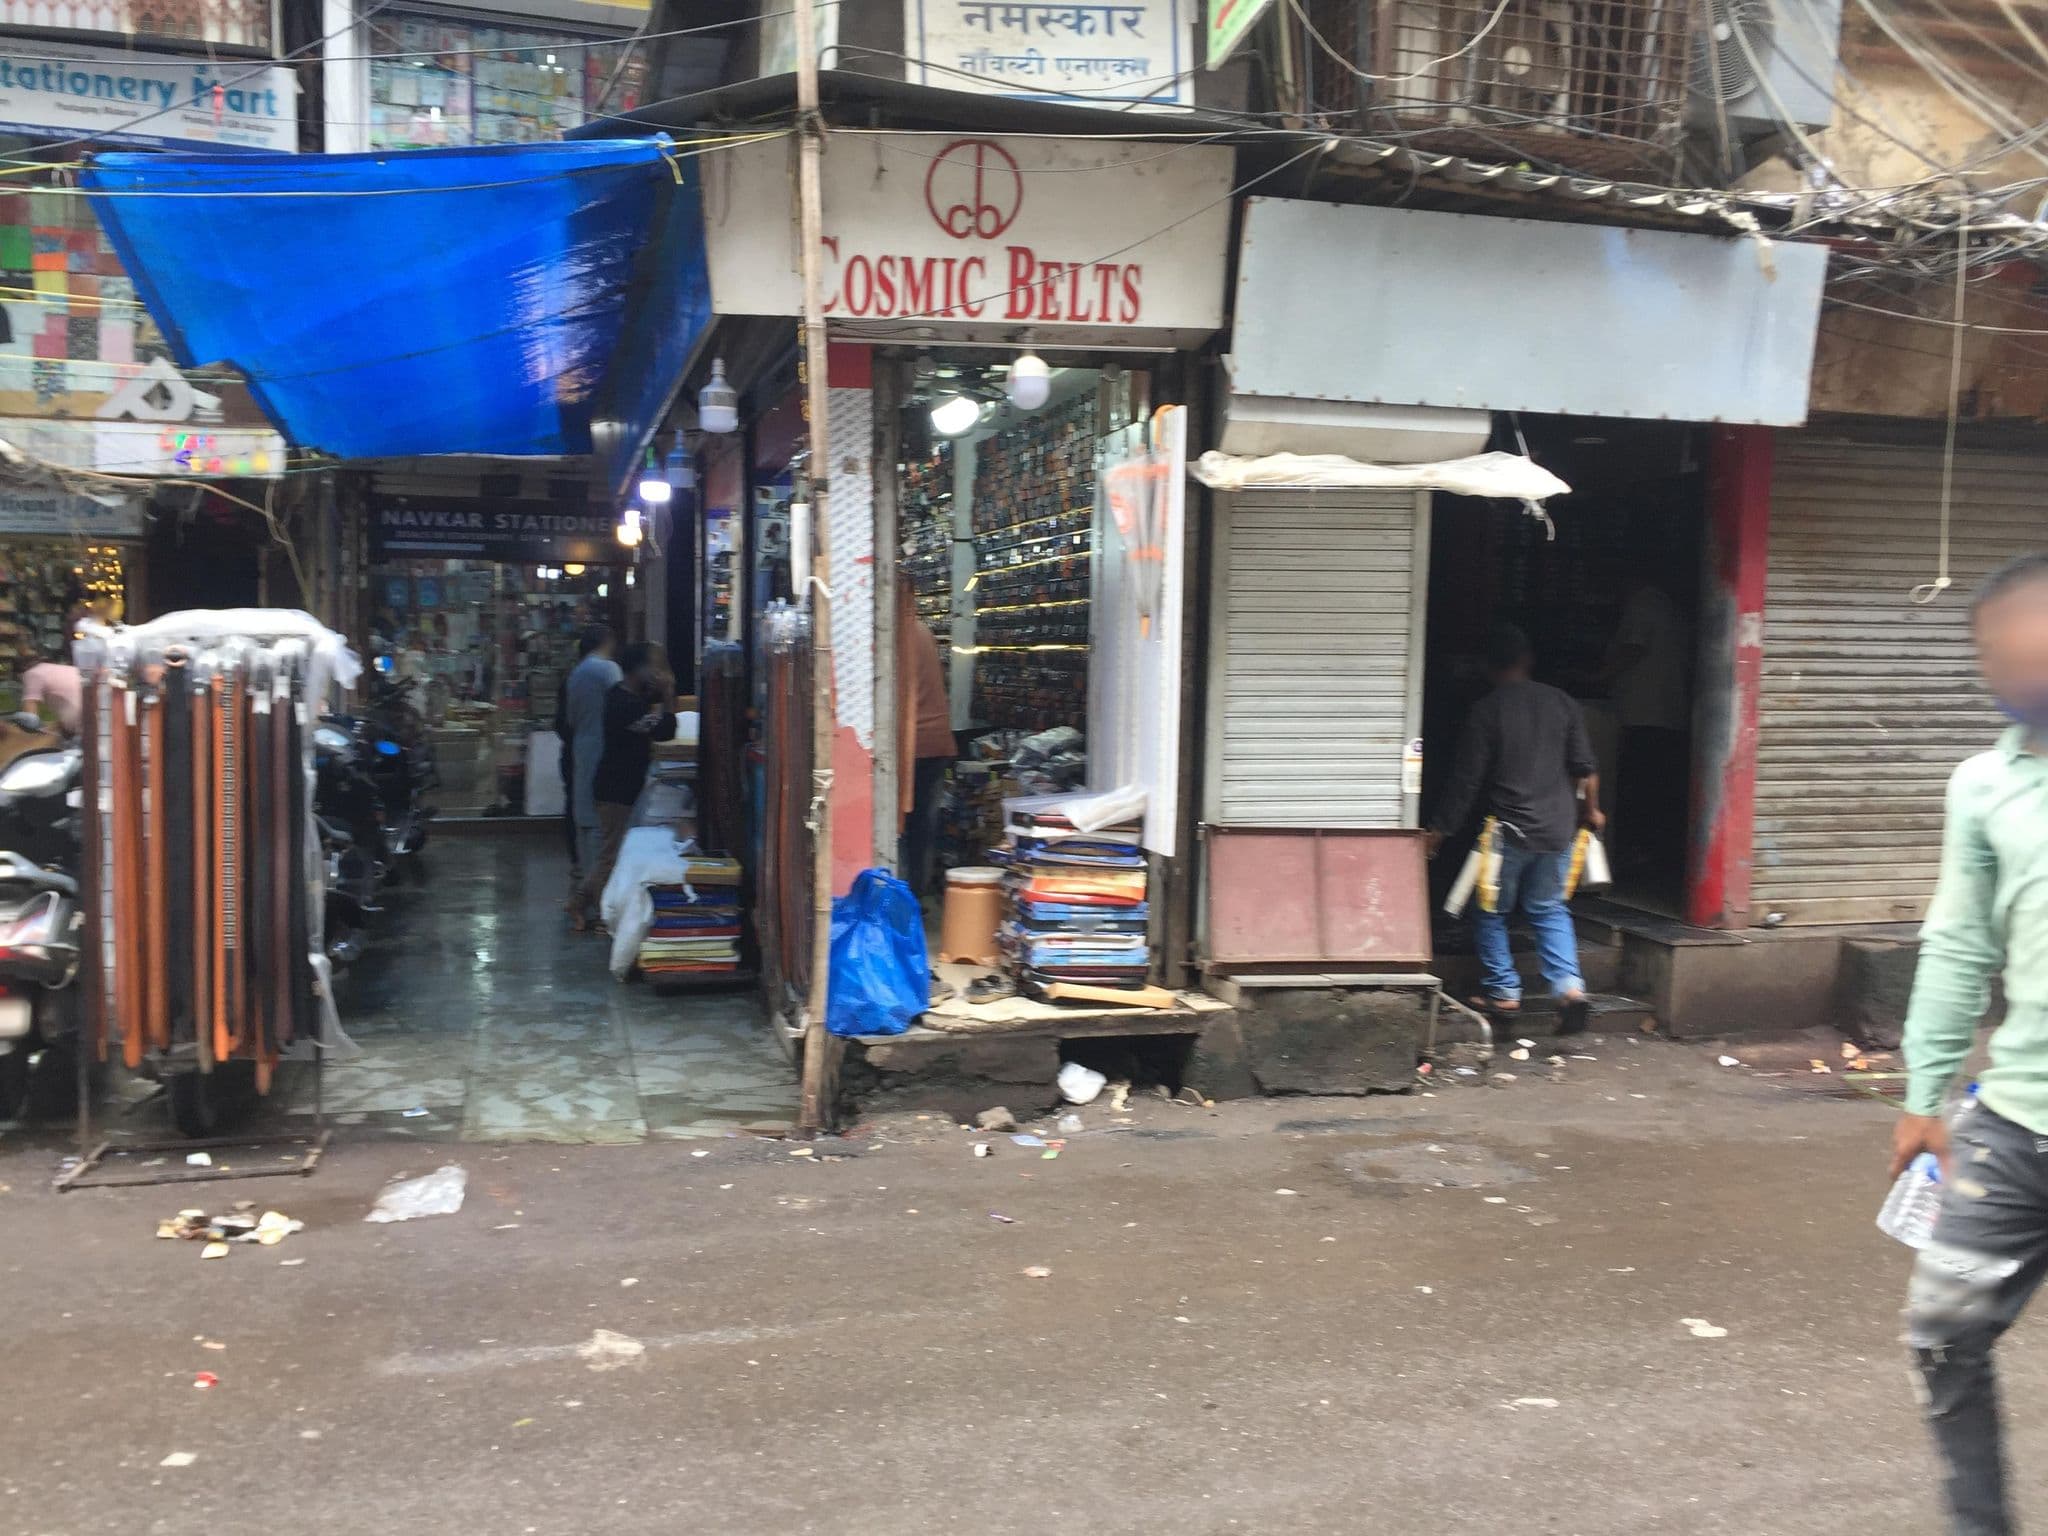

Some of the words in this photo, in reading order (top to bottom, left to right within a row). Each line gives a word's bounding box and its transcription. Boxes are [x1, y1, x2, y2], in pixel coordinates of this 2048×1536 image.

[958, 1, 1147, 38] नमस्कार
[1004, 246, 1143, 324] BELTS
[382, 510, 484, 528] NAVKAR
